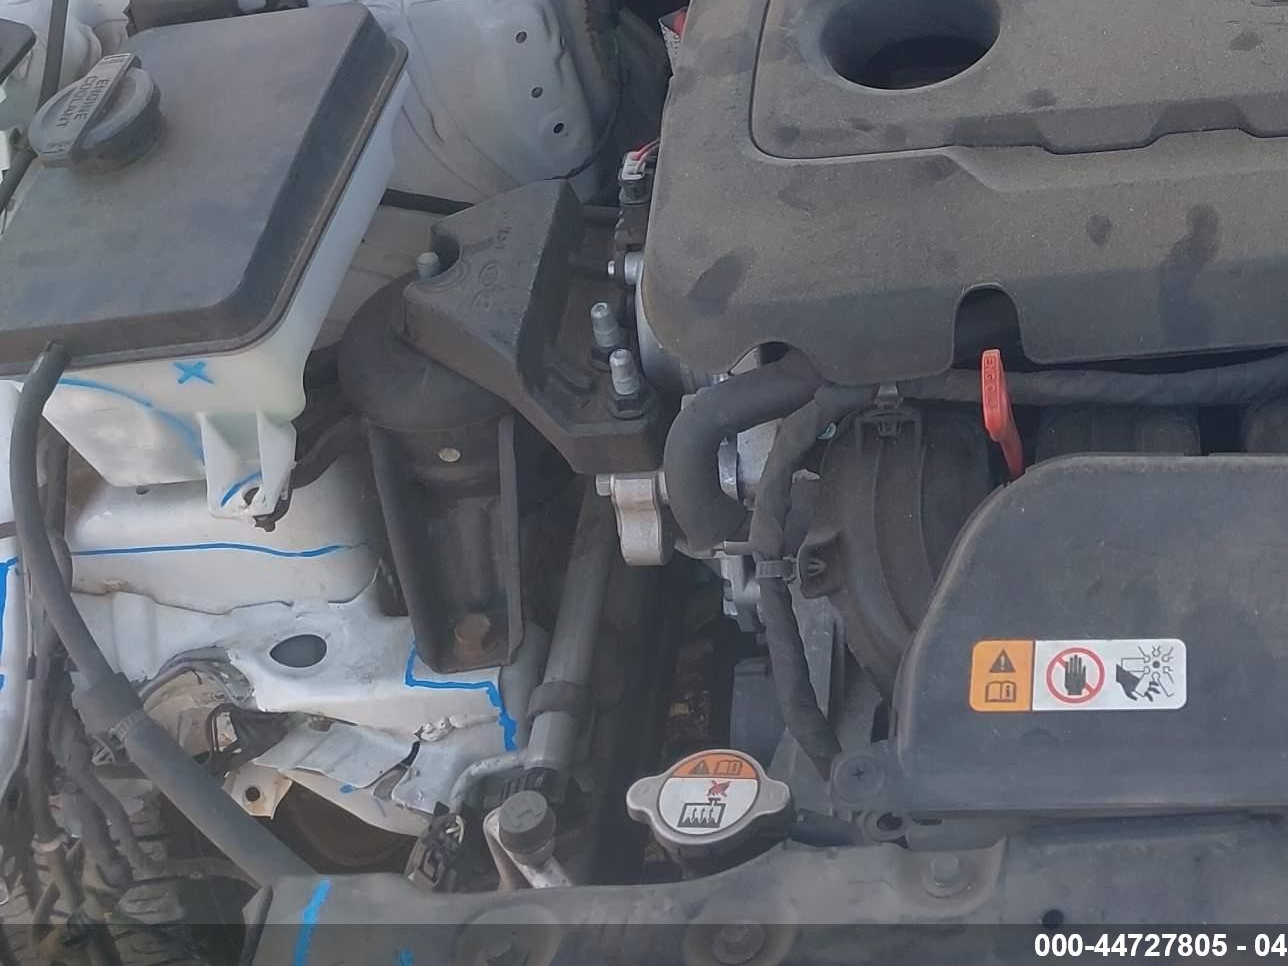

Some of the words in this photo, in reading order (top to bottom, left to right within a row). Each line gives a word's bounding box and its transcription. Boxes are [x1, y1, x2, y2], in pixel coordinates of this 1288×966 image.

[55, 75, 98, 128] COOLANT
[74, 78, 110, 121] ENGINE
[984, 356, 996, 380] ENG
